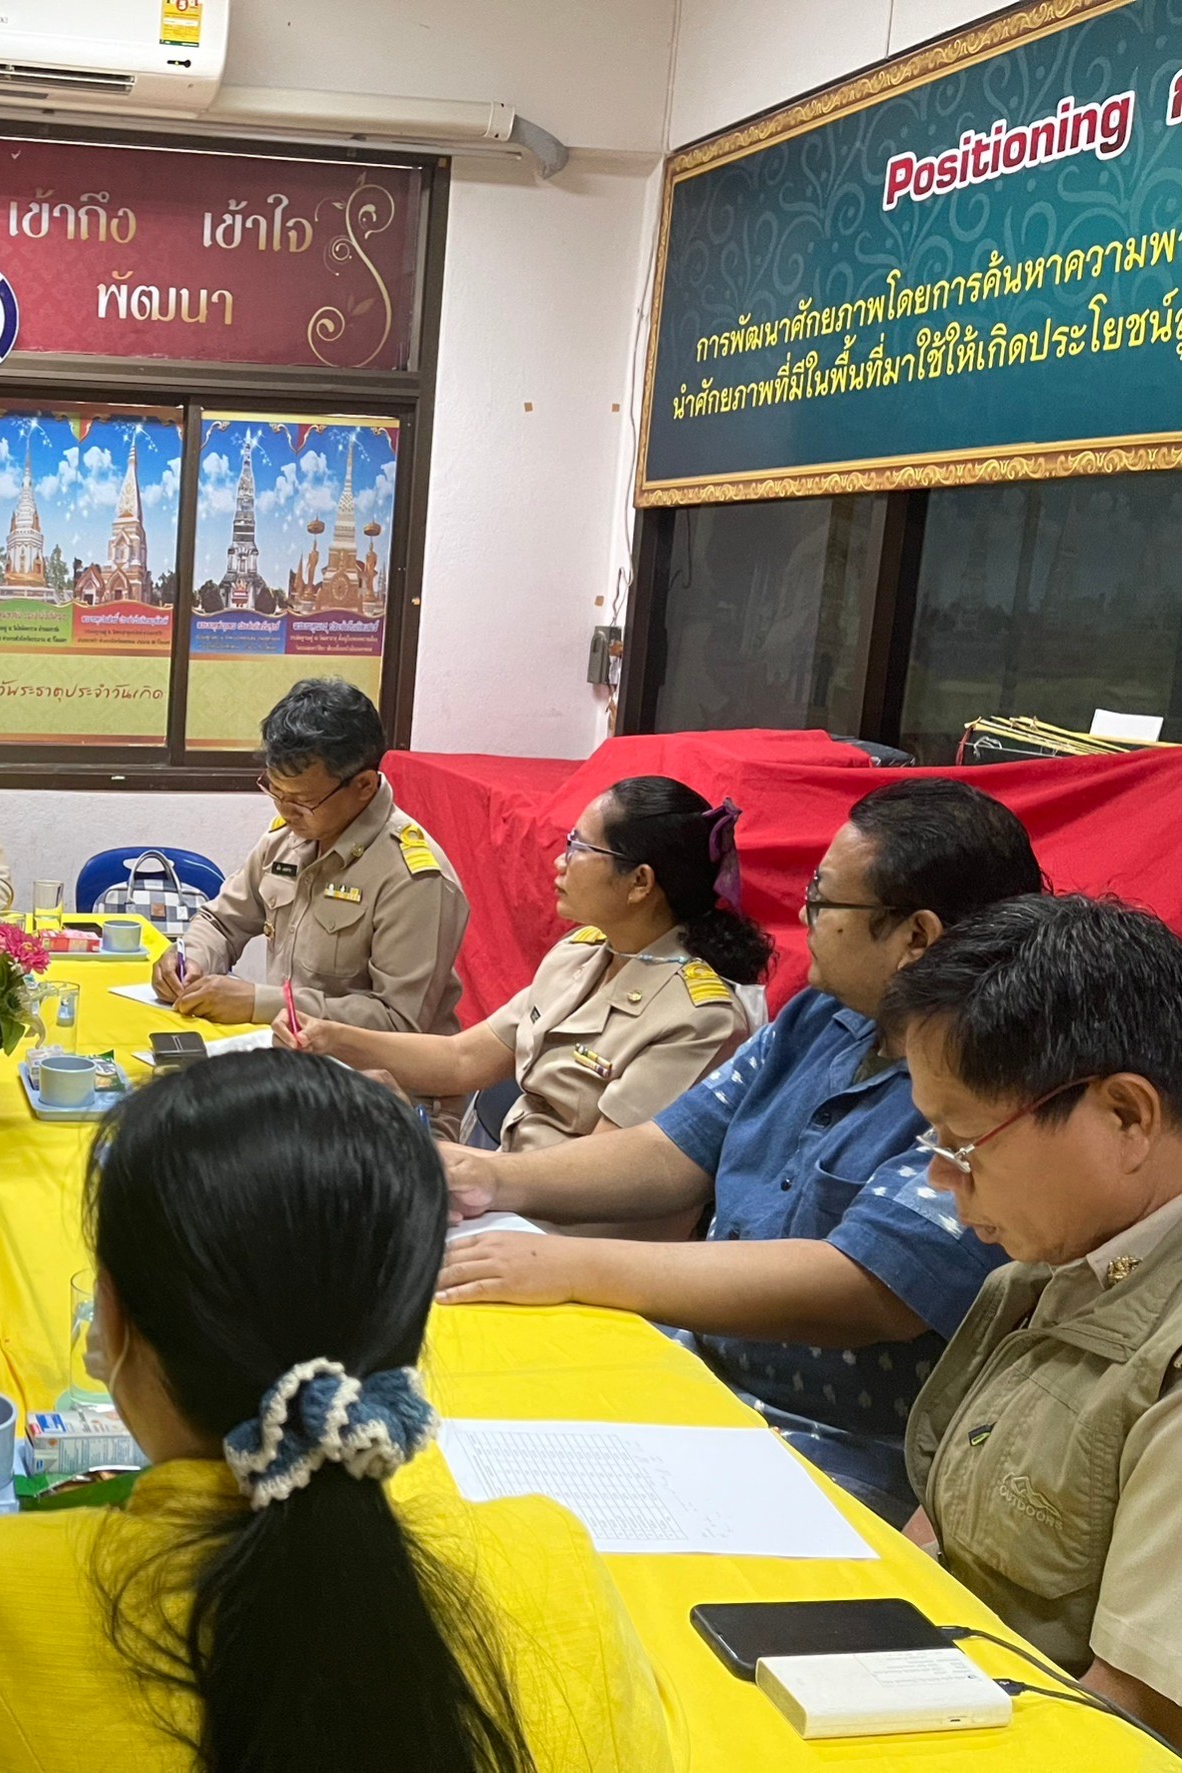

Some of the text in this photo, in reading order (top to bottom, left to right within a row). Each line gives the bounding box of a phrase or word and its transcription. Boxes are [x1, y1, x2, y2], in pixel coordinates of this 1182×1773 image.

[883, 92, 1133, 208] Positioning
[8, 188, 314, 253] เข้าถึง เข้าใจ
[97, 270, 234, 326] พัฒนา
[999, 1485, 1063, 1530] OUTDOORS
